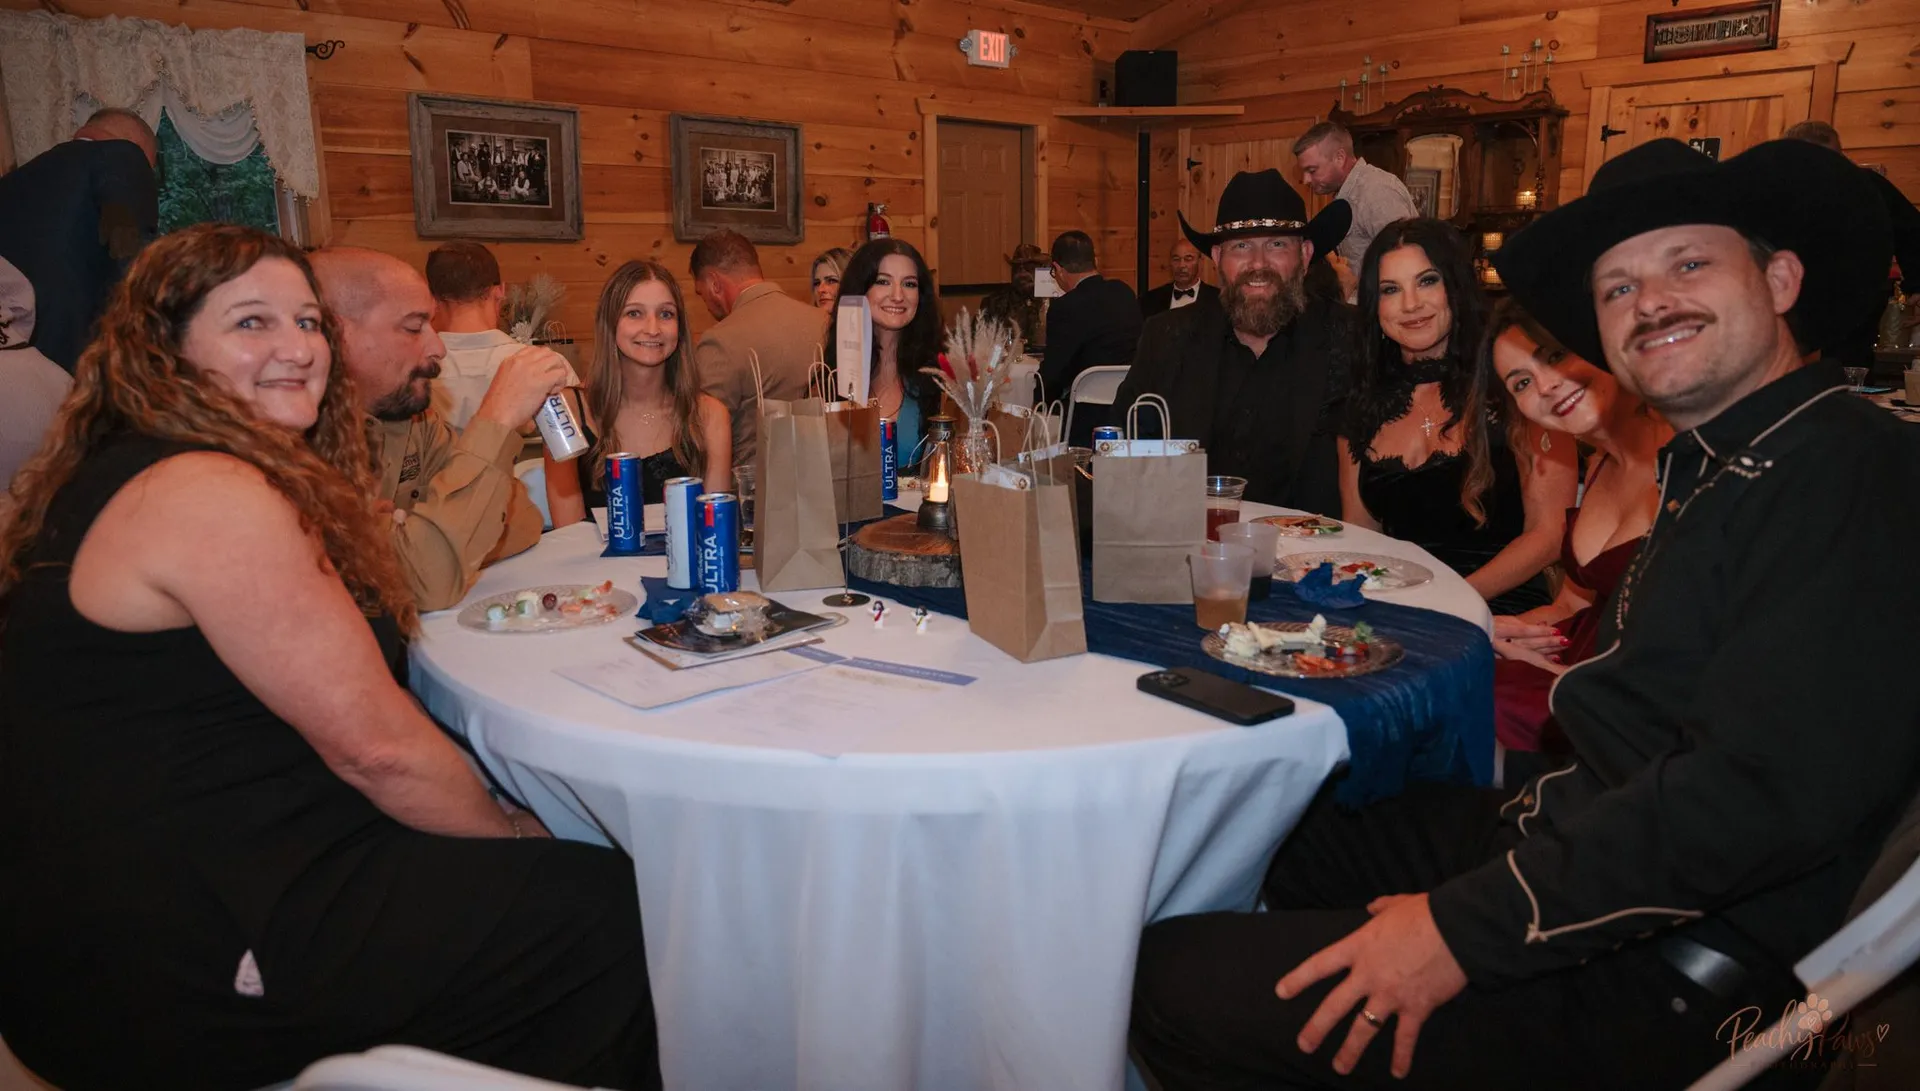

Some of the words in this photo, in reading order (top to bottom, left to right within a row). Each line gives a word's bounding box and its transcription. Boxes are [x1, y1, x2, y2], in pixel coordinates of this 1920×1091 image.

[979, 31, 1006, 63] EXIT
[549, 396, 576, 438] ULTR
[884, 444, 895, 490] ULTRA
[611, 484, 624, 538] ULTRA
